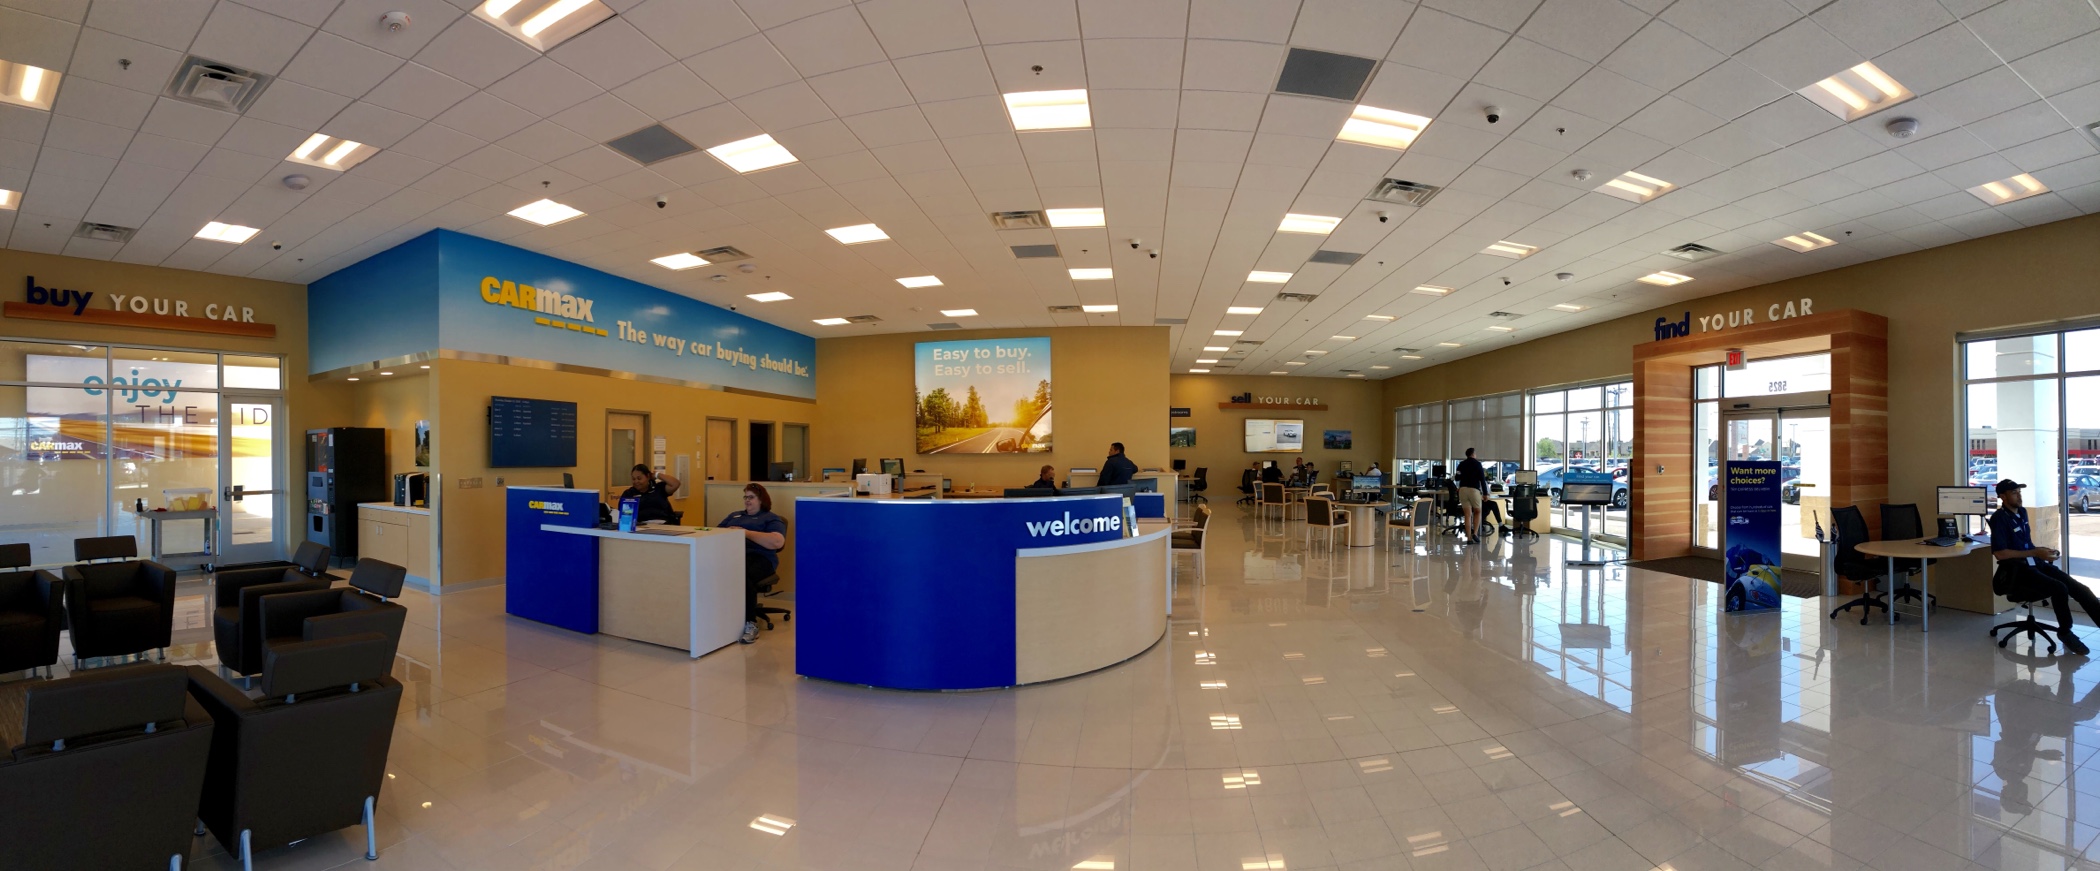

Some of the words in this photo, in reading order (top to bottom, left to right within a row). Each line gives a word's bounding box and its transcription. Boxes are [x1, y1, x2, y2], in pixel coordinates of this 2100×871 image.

[26, 276, 93, 316] buy
[110, 293, 189, 317] YOUR
[205, 303, 255, 323] CAR
[480, 276, 594, 323] CARmax
[1654, 311, 1690, 341] find
[1699, 308, 1754, 333] YOUR
[1768, 298, 1813, 321] CAR
[616, 320, 647, 344] The
[652, 333, 686, 356] way
[690, 340, 712, 357] car
[716, 342, 757, 370] buying
[760, 353, 793, 374] should
[933, 348, 970, 362] Easy
[974, 347, 991, 359] to
[995, 345, 1031, 360] buy.
[1729, 351, 1741, 366] EXIT
[935, 364, 971, 378] Easy
[975, 363, 992, 375] to
[996, 360, 1031, 374] sell.
[83, 369, 182, 404] enjoy
[1231, 392, 1251, 404] sell
[1258, 396, 1289, 405] YOUR
[1295, 397, 1319, 406] CAR
[135, 405, 198, 424] THE
[240, 407, 269, 425] ID
[1730, 467, 1753, 475] Want
[1730, 476, 1766, 484] choices?
[1025, 511, 1121, 538] welcome
